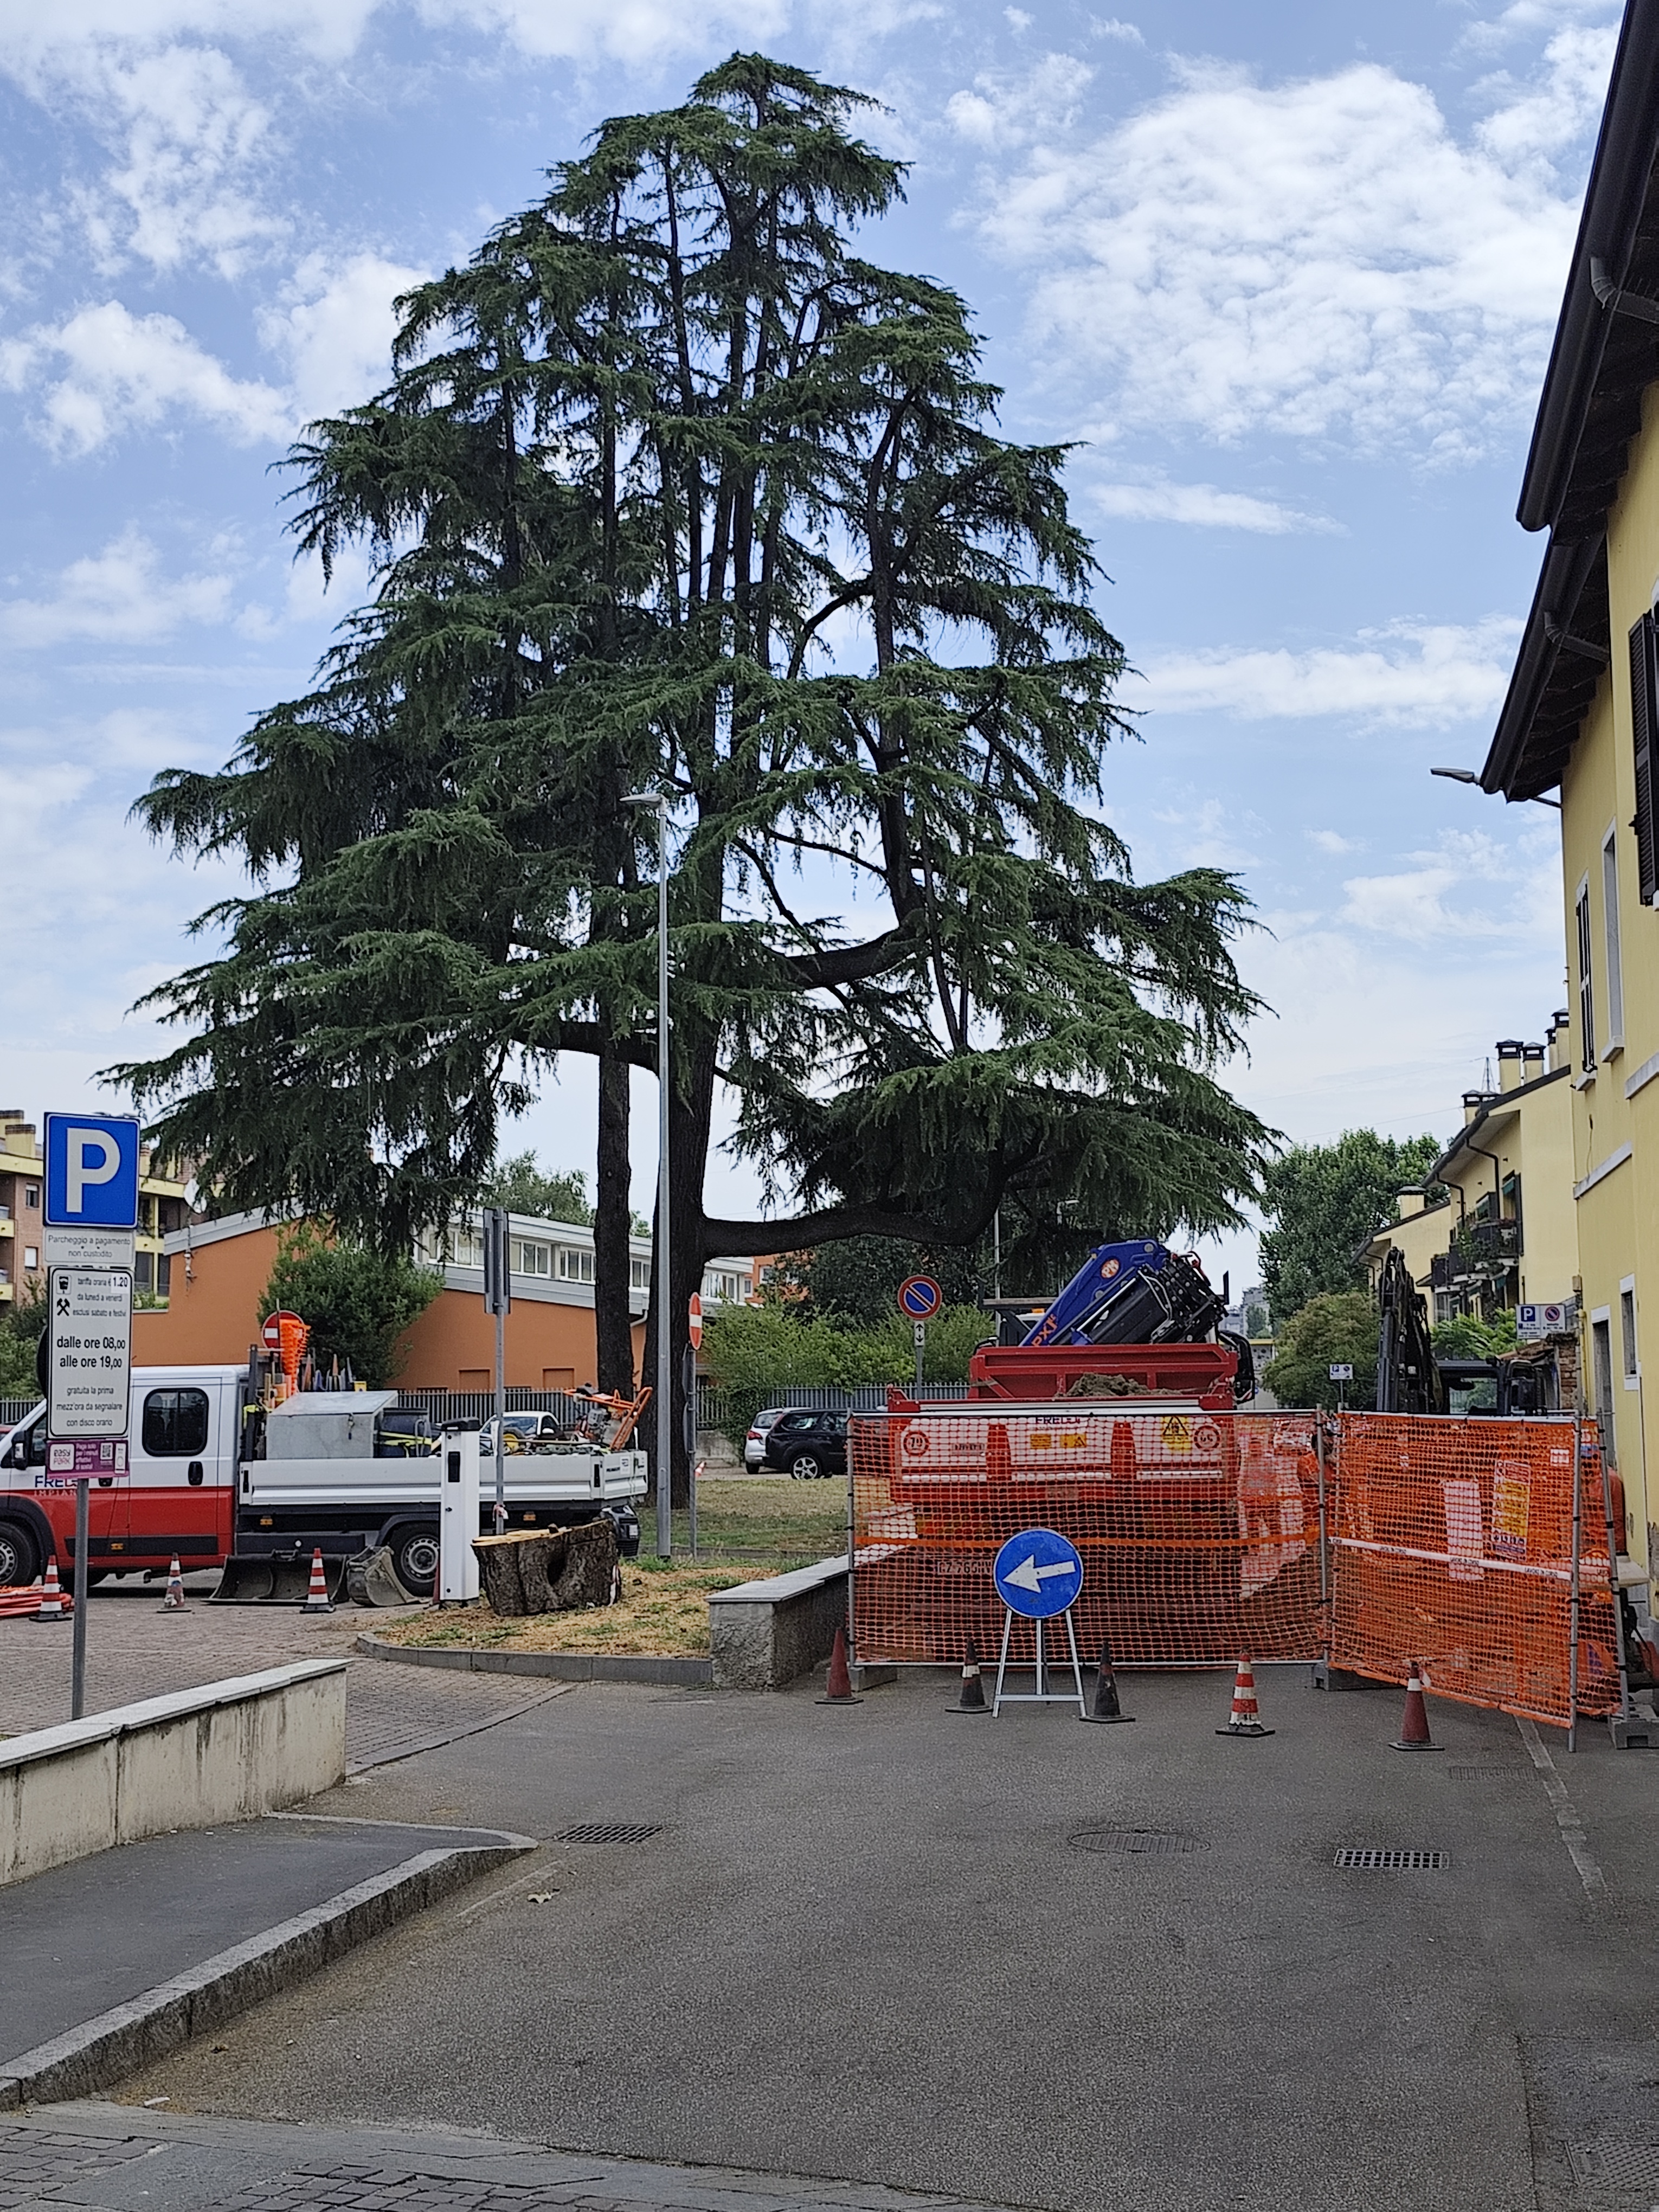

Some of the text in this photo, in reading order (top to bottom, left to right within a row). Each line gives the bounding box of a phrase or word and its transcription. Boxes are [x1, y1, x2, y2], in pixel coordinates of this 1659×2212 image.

[67, 1127, 120, 1213] P
[48, 1234, 87, 1245] Parcheggio
[95, 1238, 131, 1246] pagamento
[1523, 1308, 1533, 1321] P
[57, 1336, 125, 1351] dalle ore 08,00
[60, 1355, 122, 1370] alle ore 19,00
[67, 1387, 89, 1396] gratuita
[98, 1387, 114, 1396] prima
[95, 1402, 123, 1412] segnalare
[96, 1418, 112, 1426] orario
